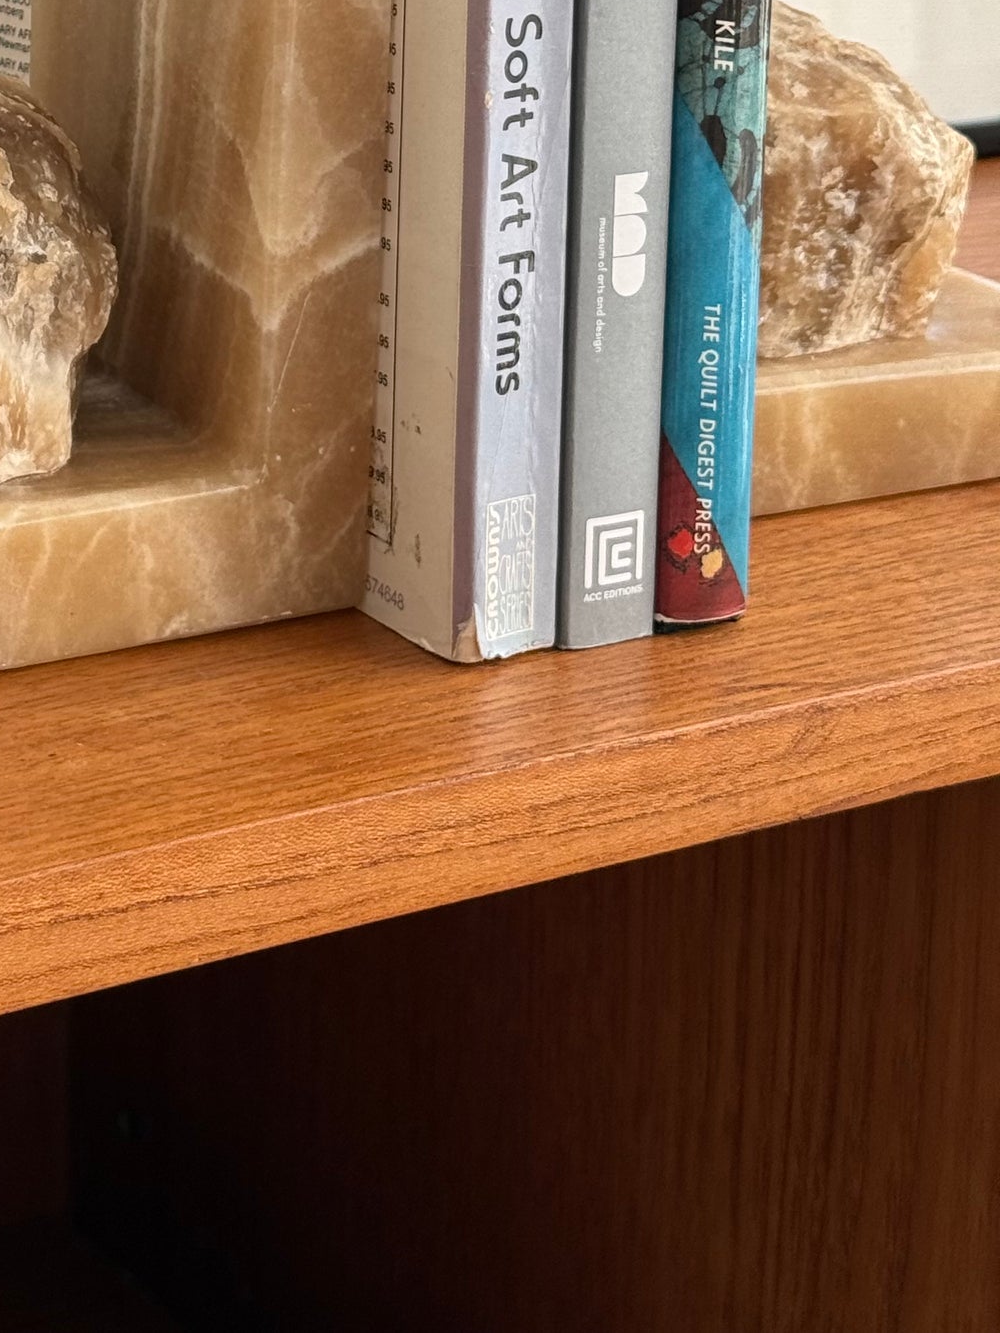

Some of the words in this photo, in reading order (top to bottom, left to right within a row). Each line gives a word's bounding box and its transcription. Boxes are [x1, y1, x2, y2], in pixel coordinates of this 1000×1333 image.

[714, 19, 735, 72] KILE
[503, 14, 543, 132] Soft
[499, 153, 538, 232] Art
[598, 217, 607, 261] museum
[597, 274, 606, 293] arts
[598, 262, 608, 272] of
[495, 250, 536, 396] Forms
[596, 297, 606, 316] and
[703, 304, 721, 343] THE
[593, 321, 605, 353] design
[697, 352, 720, 411] QUILT
[696, 419, 716, 490] DIGEST
[502, 498, 533, 542] ARTS
[694, 496, 712, 553] PRESS
[501, 591, 531, 634] SERIES
[584, 591, 602, 603] ACC
[604, 584, 643, 599] EDITIONS
